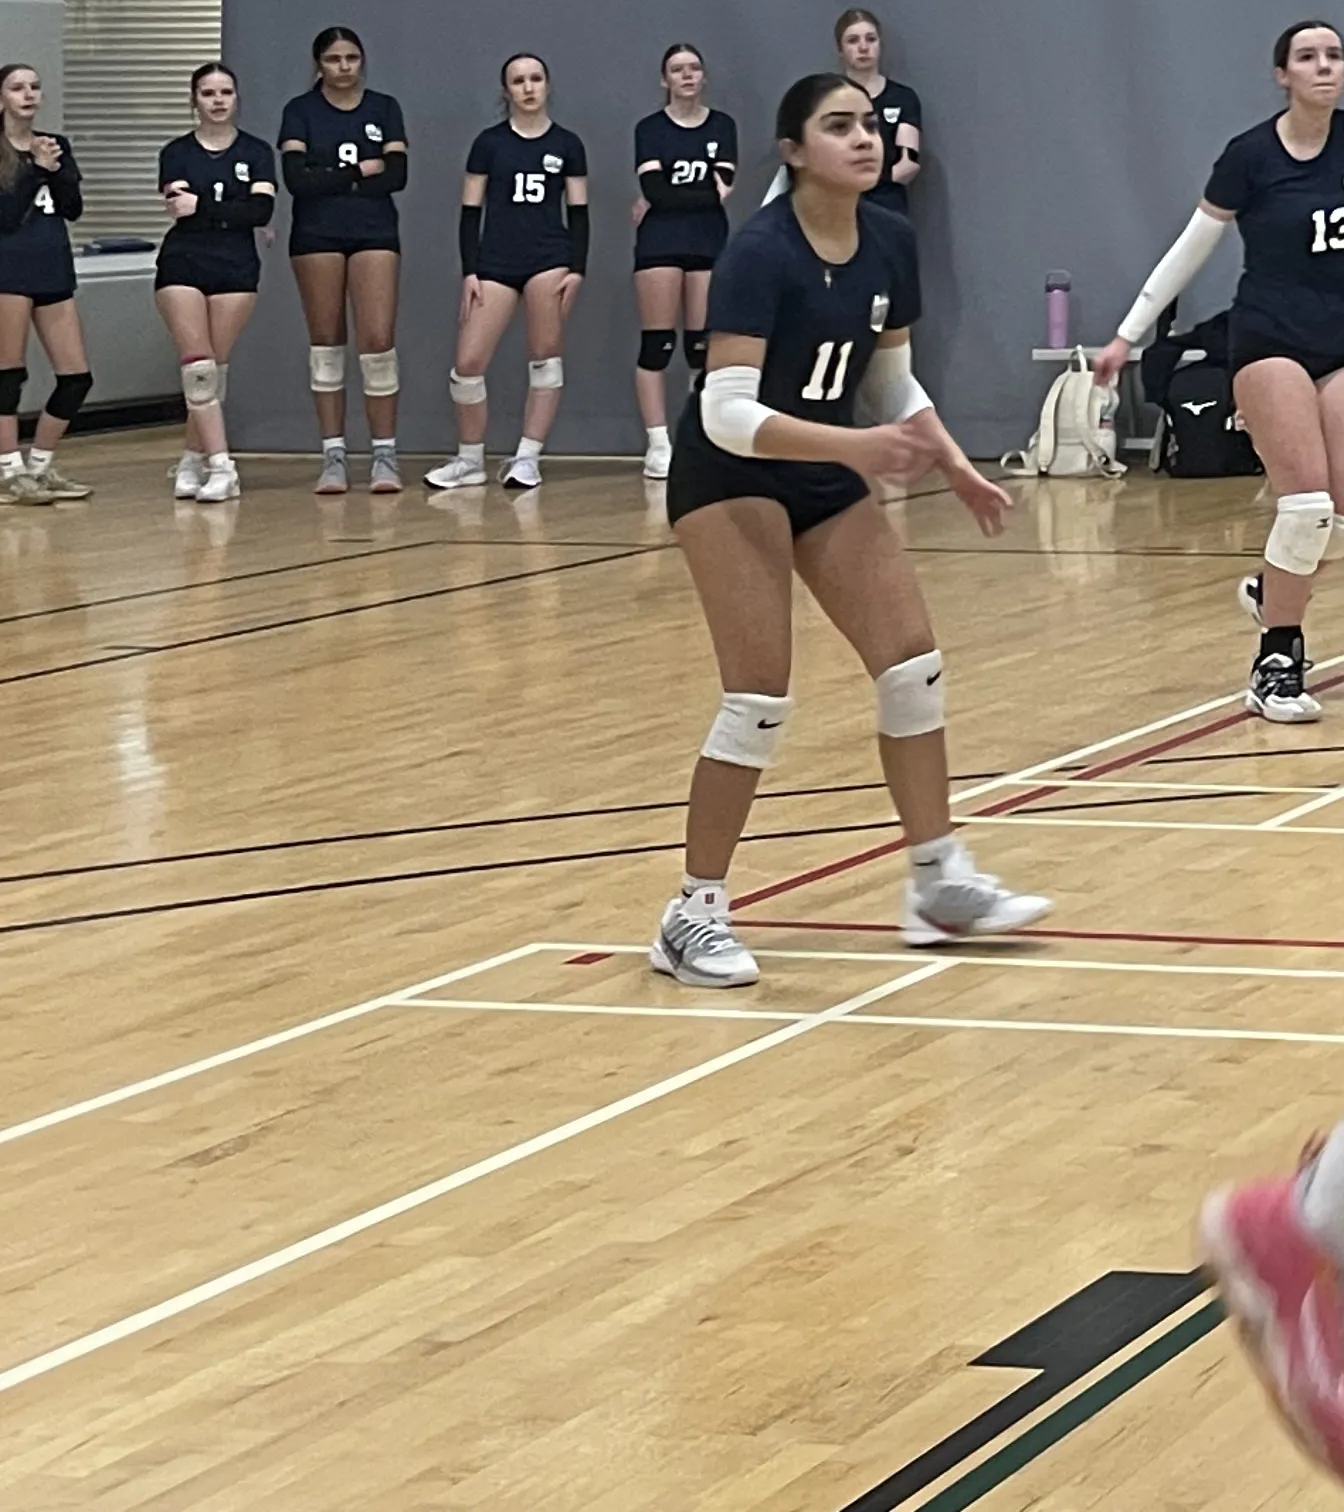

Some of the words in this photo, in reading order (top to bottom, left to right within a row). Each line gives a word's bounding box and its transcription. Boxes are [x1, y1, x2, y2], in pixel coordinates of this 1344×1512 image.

[338, 142, 358, 168] 9
[34, 184, 56, 215] 4
[213, 181, 224, 202] 1
[512, 172, 546, 204] 15
[801, 340, 854, 401] 11
